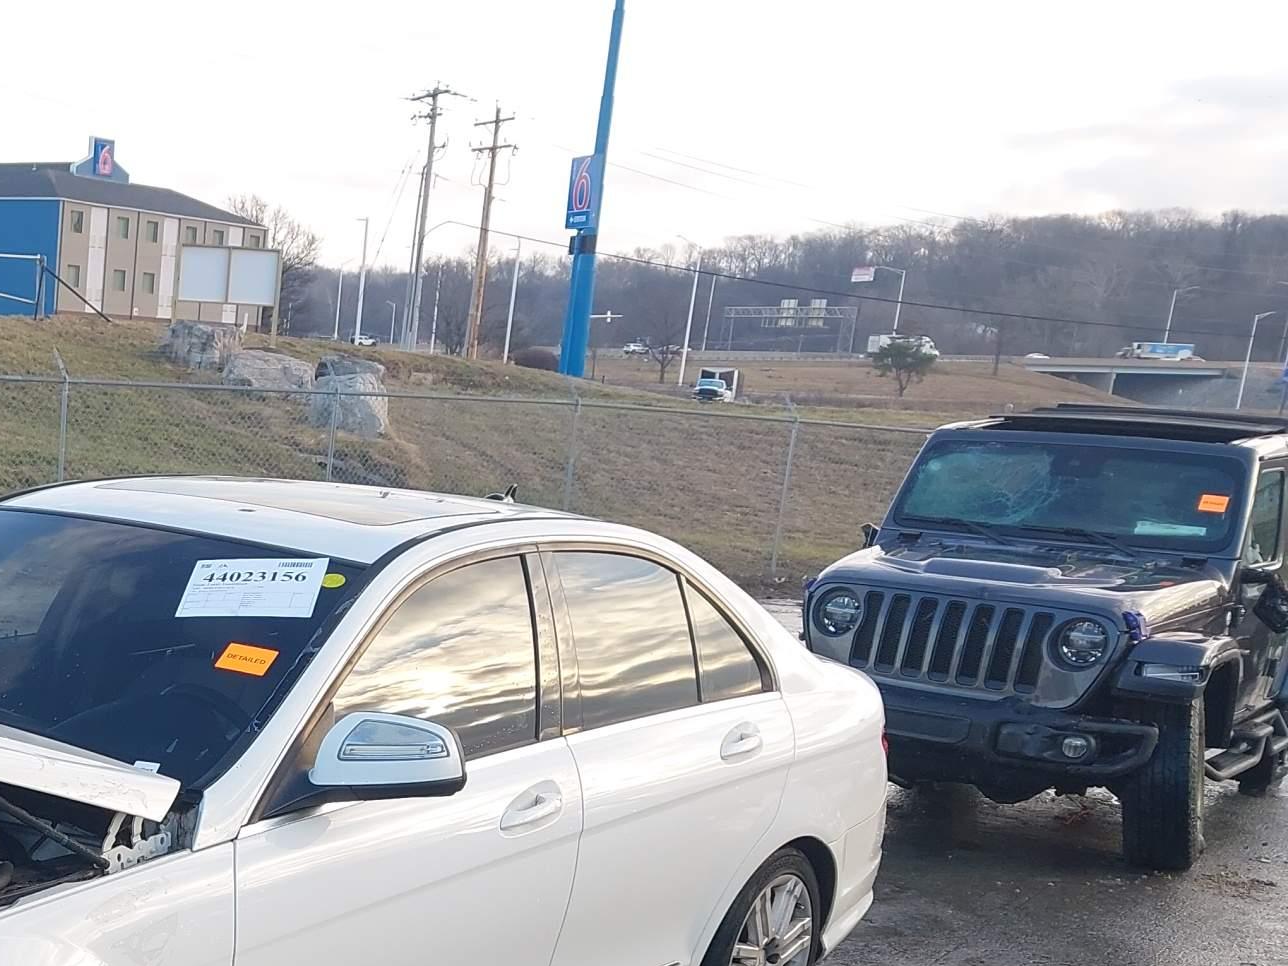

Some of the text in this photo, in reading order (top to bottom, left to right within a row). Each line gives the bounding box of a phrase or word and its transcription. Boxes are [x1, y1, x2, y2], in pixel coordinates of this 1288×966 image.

[98, 144, 112, 175] 6
[573, 157, 592, 211] 6
[202, 571, 307, 583] 44023156
[226, 652, 267, 665] DETAILED
